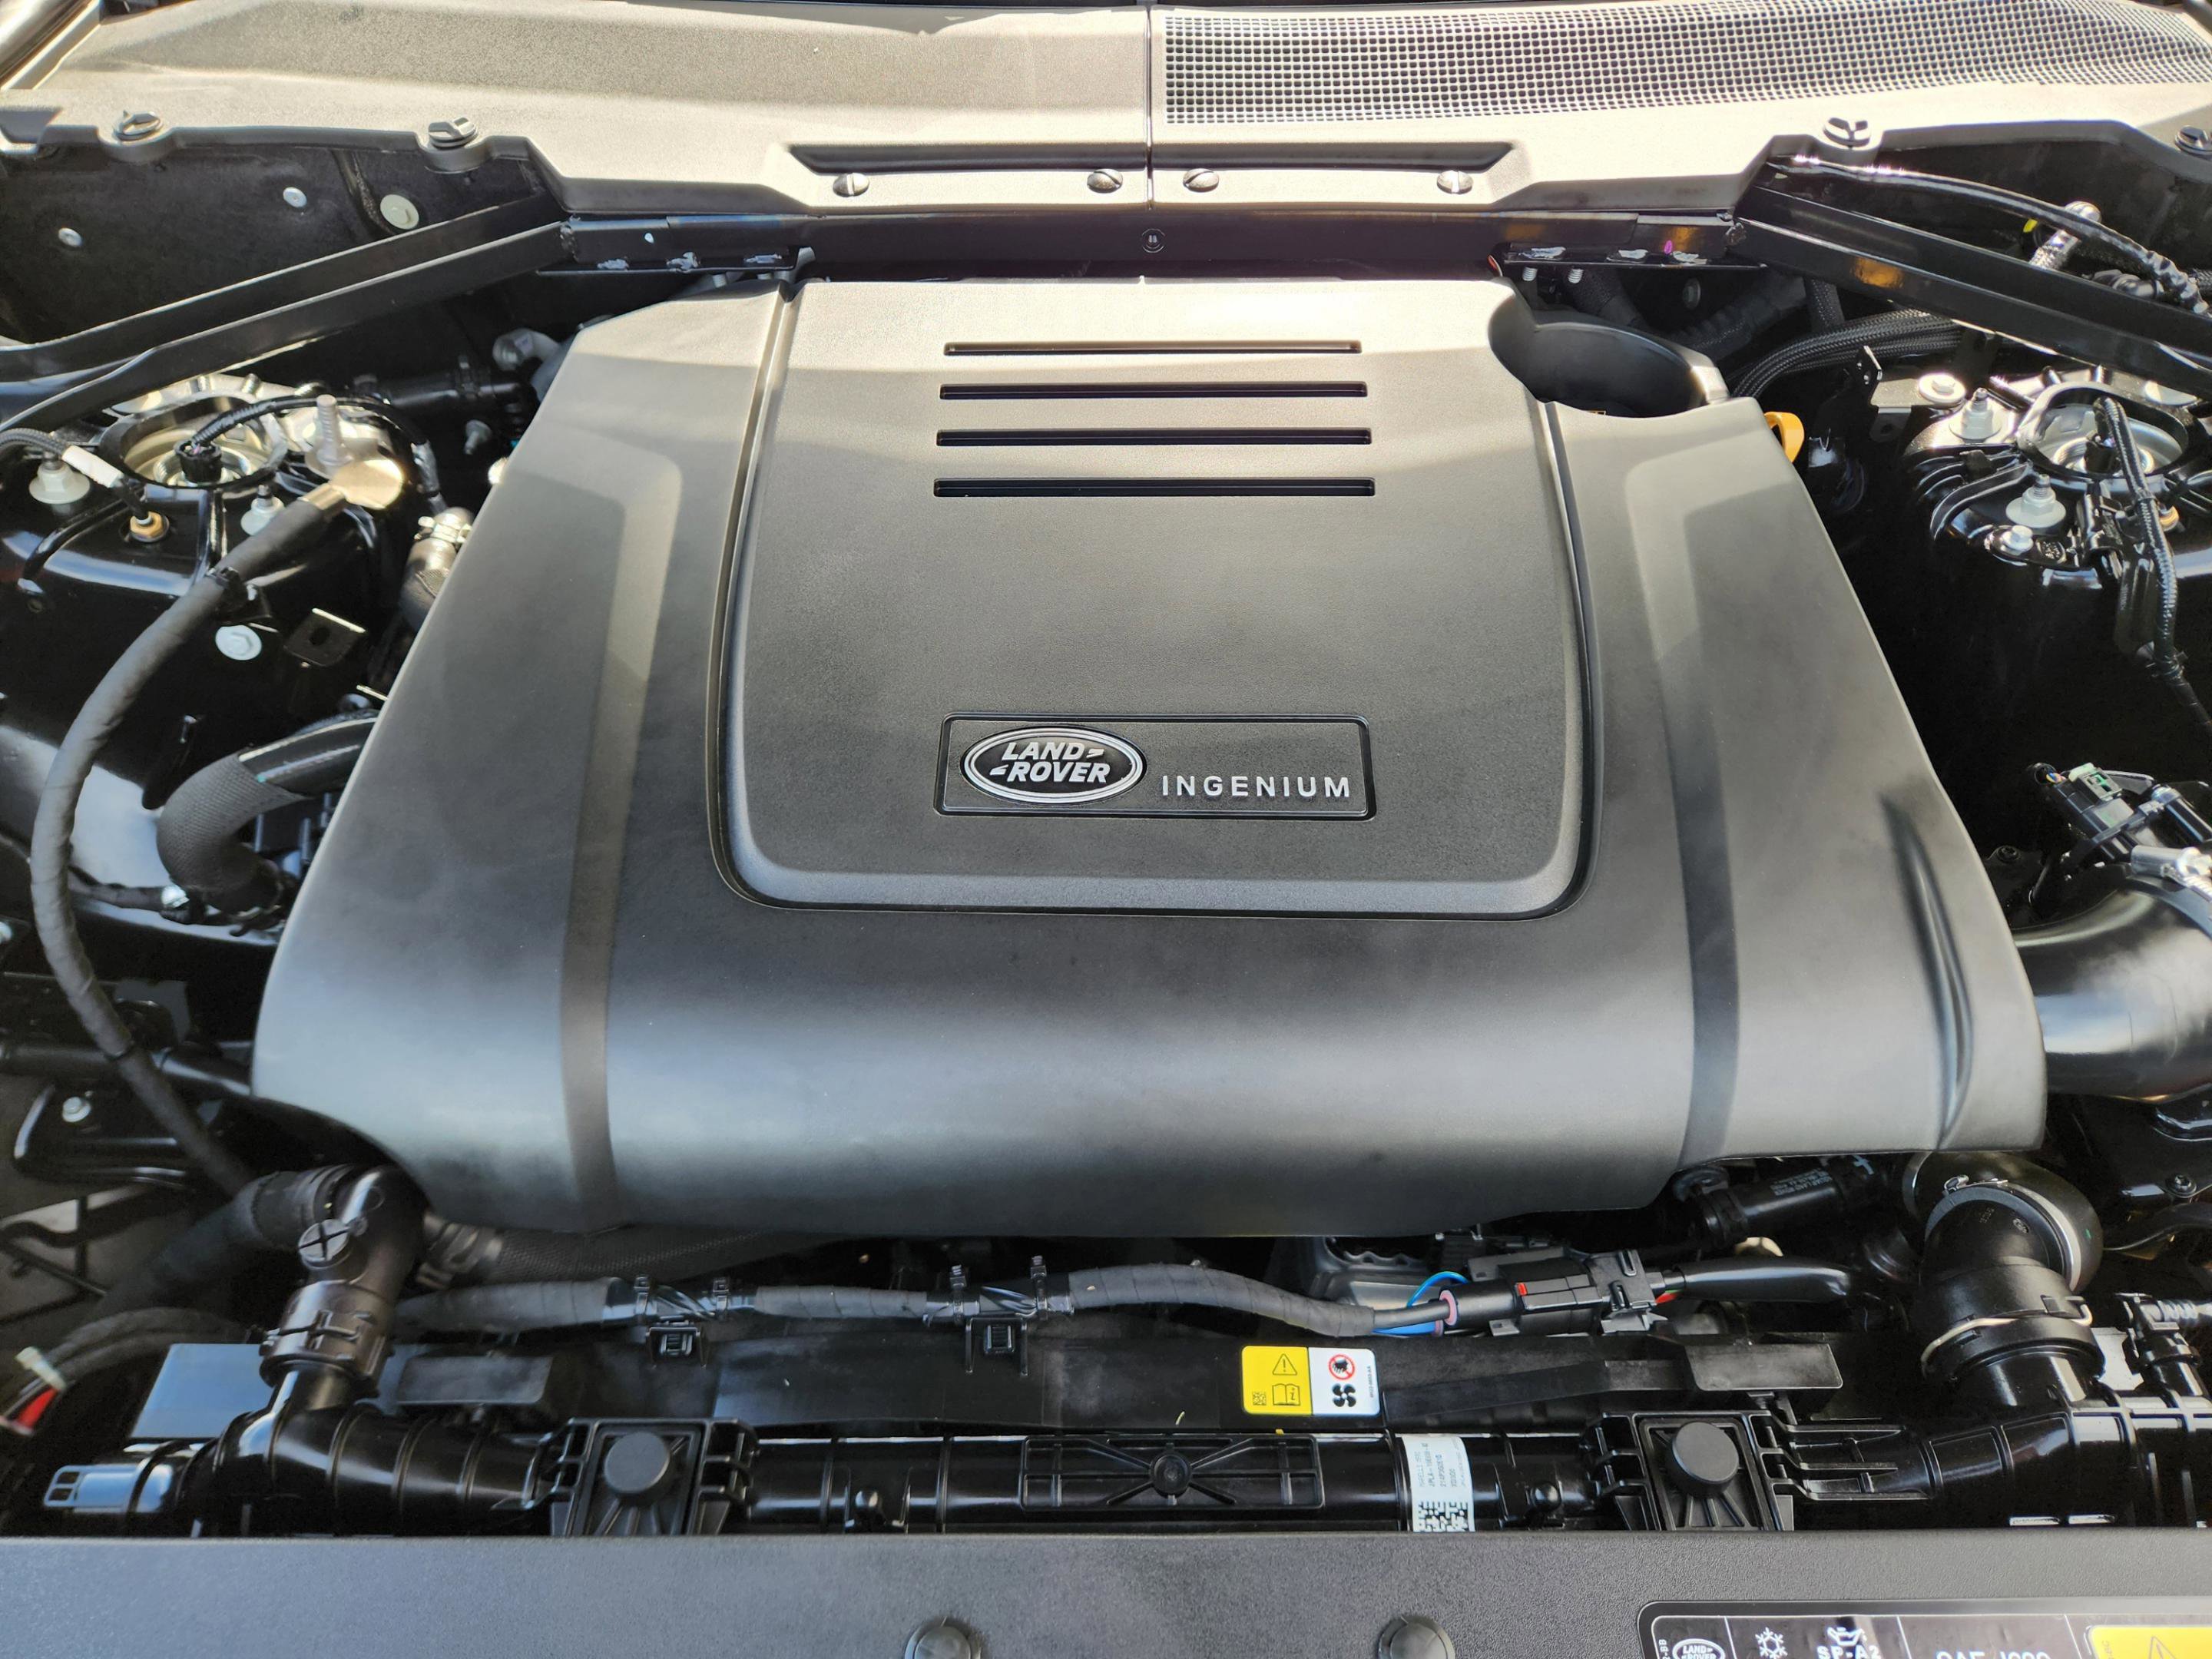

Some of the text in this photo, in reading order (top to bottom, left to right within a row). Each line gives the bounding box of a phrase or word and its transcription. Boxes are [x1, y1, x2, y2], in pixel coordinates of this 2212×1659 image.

[1002, 742, 1084, 761] LAND
[1006, 760, 1111, 783] ROVER
[1162, 775, 1350, 798] INGENIUM
[1683, 1645, 1707, 1654] LAND
